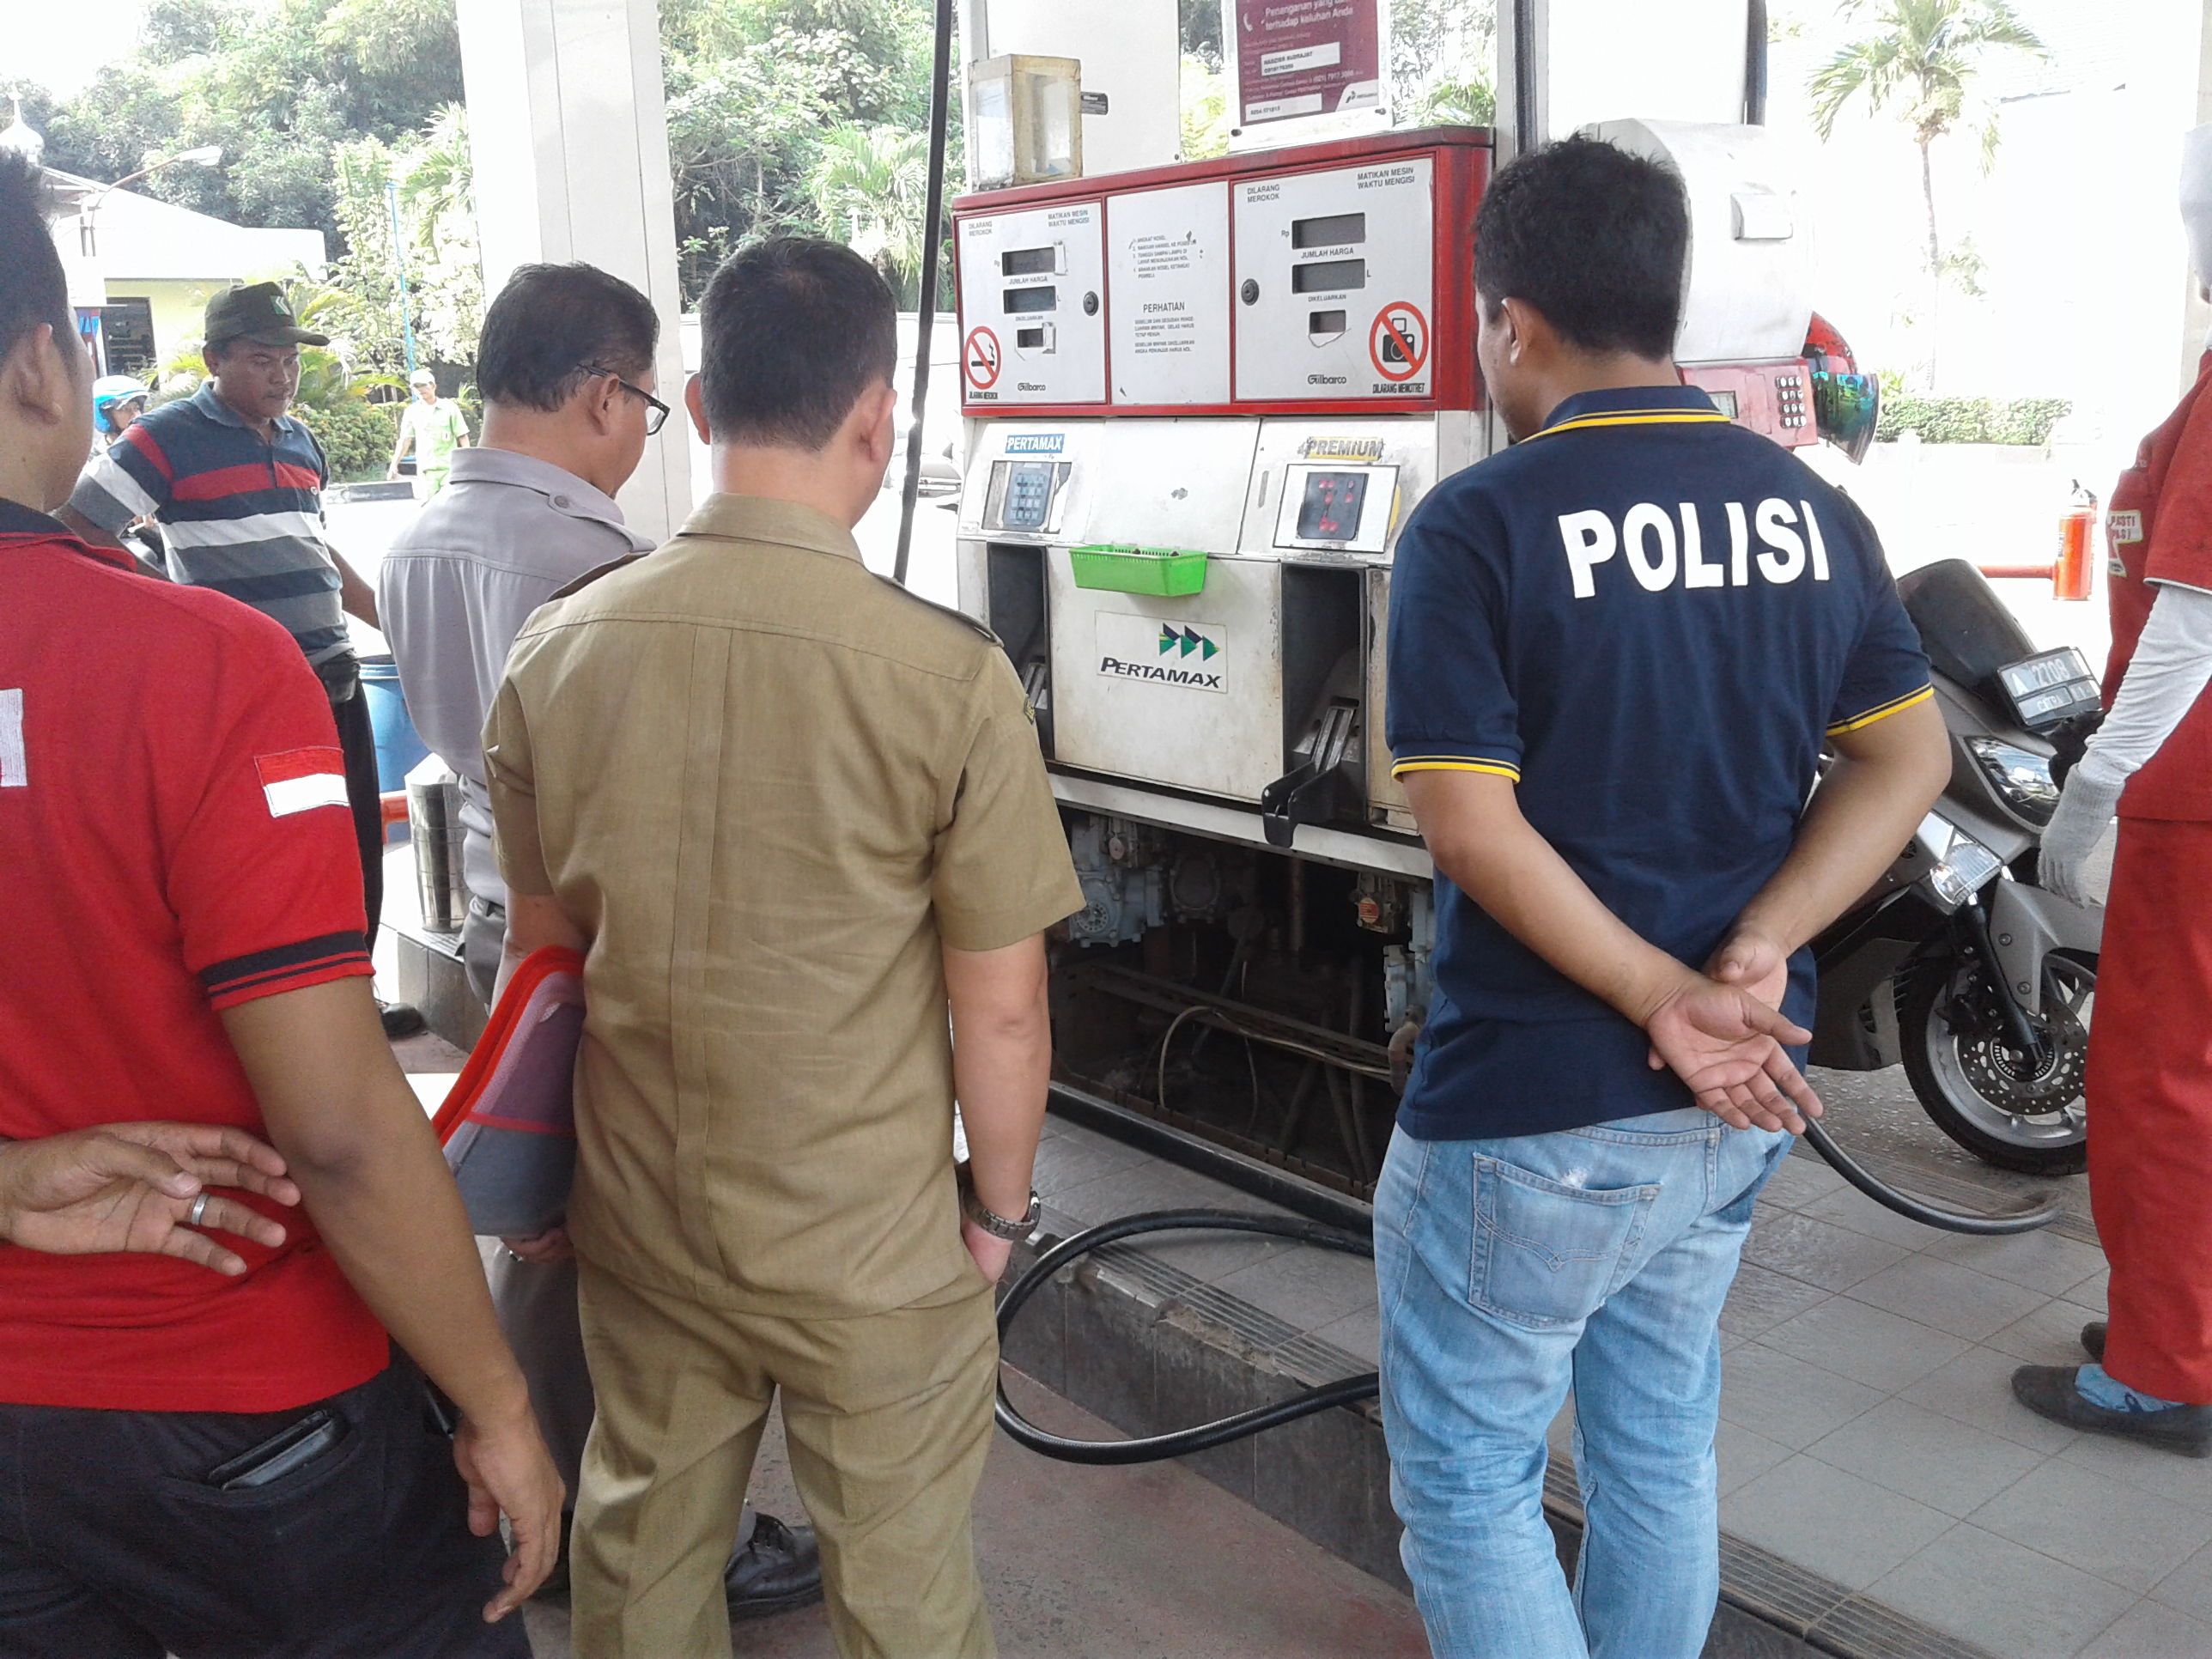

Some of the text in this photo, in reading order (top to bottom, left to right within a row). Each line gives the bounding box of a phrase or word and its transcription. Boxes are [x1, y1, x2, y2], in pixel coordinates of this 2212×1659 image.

[1266, 5, 1354, 31] terhadap keluhan Anda
[1357, 167, 1414, 181] MATIKAN MESIN
[1357, 175, 1415, 190] WAKTU MENGISI
[1247, 184, 1280, 195] DILARANG
[1247, 193, 1280, 204] MEROKOK
[1048, 209, 1088, 220] MATIKAN MESIN
[968, 221, 993, 229] DILARANG
[1048, 216, 1090, 228] WAKTU MENGISI
[1280, 229, 1290, 239] Rp
[1300, 246, 1354, 258] JUMLAH HARGA
[1143, 301, 1185, 313] PERHATIAN
[1307, 374, 1347, 385] Gilbarco
[1017, 382, 1046, 392] Gilbarco
[1372, 383, 1397, 394] DILARANG
[1006, 435, 1062, 452] PERTAMAX
[1304, 438, 1382, 458] PREMIUM
[2111, 515, 2136, 526] PASTI
[1558, 497, 1830, 599] POLISI
[1100, 656, 1223, 690] PERTAMAX
[2011, 658, 2070, 695] A 2708
